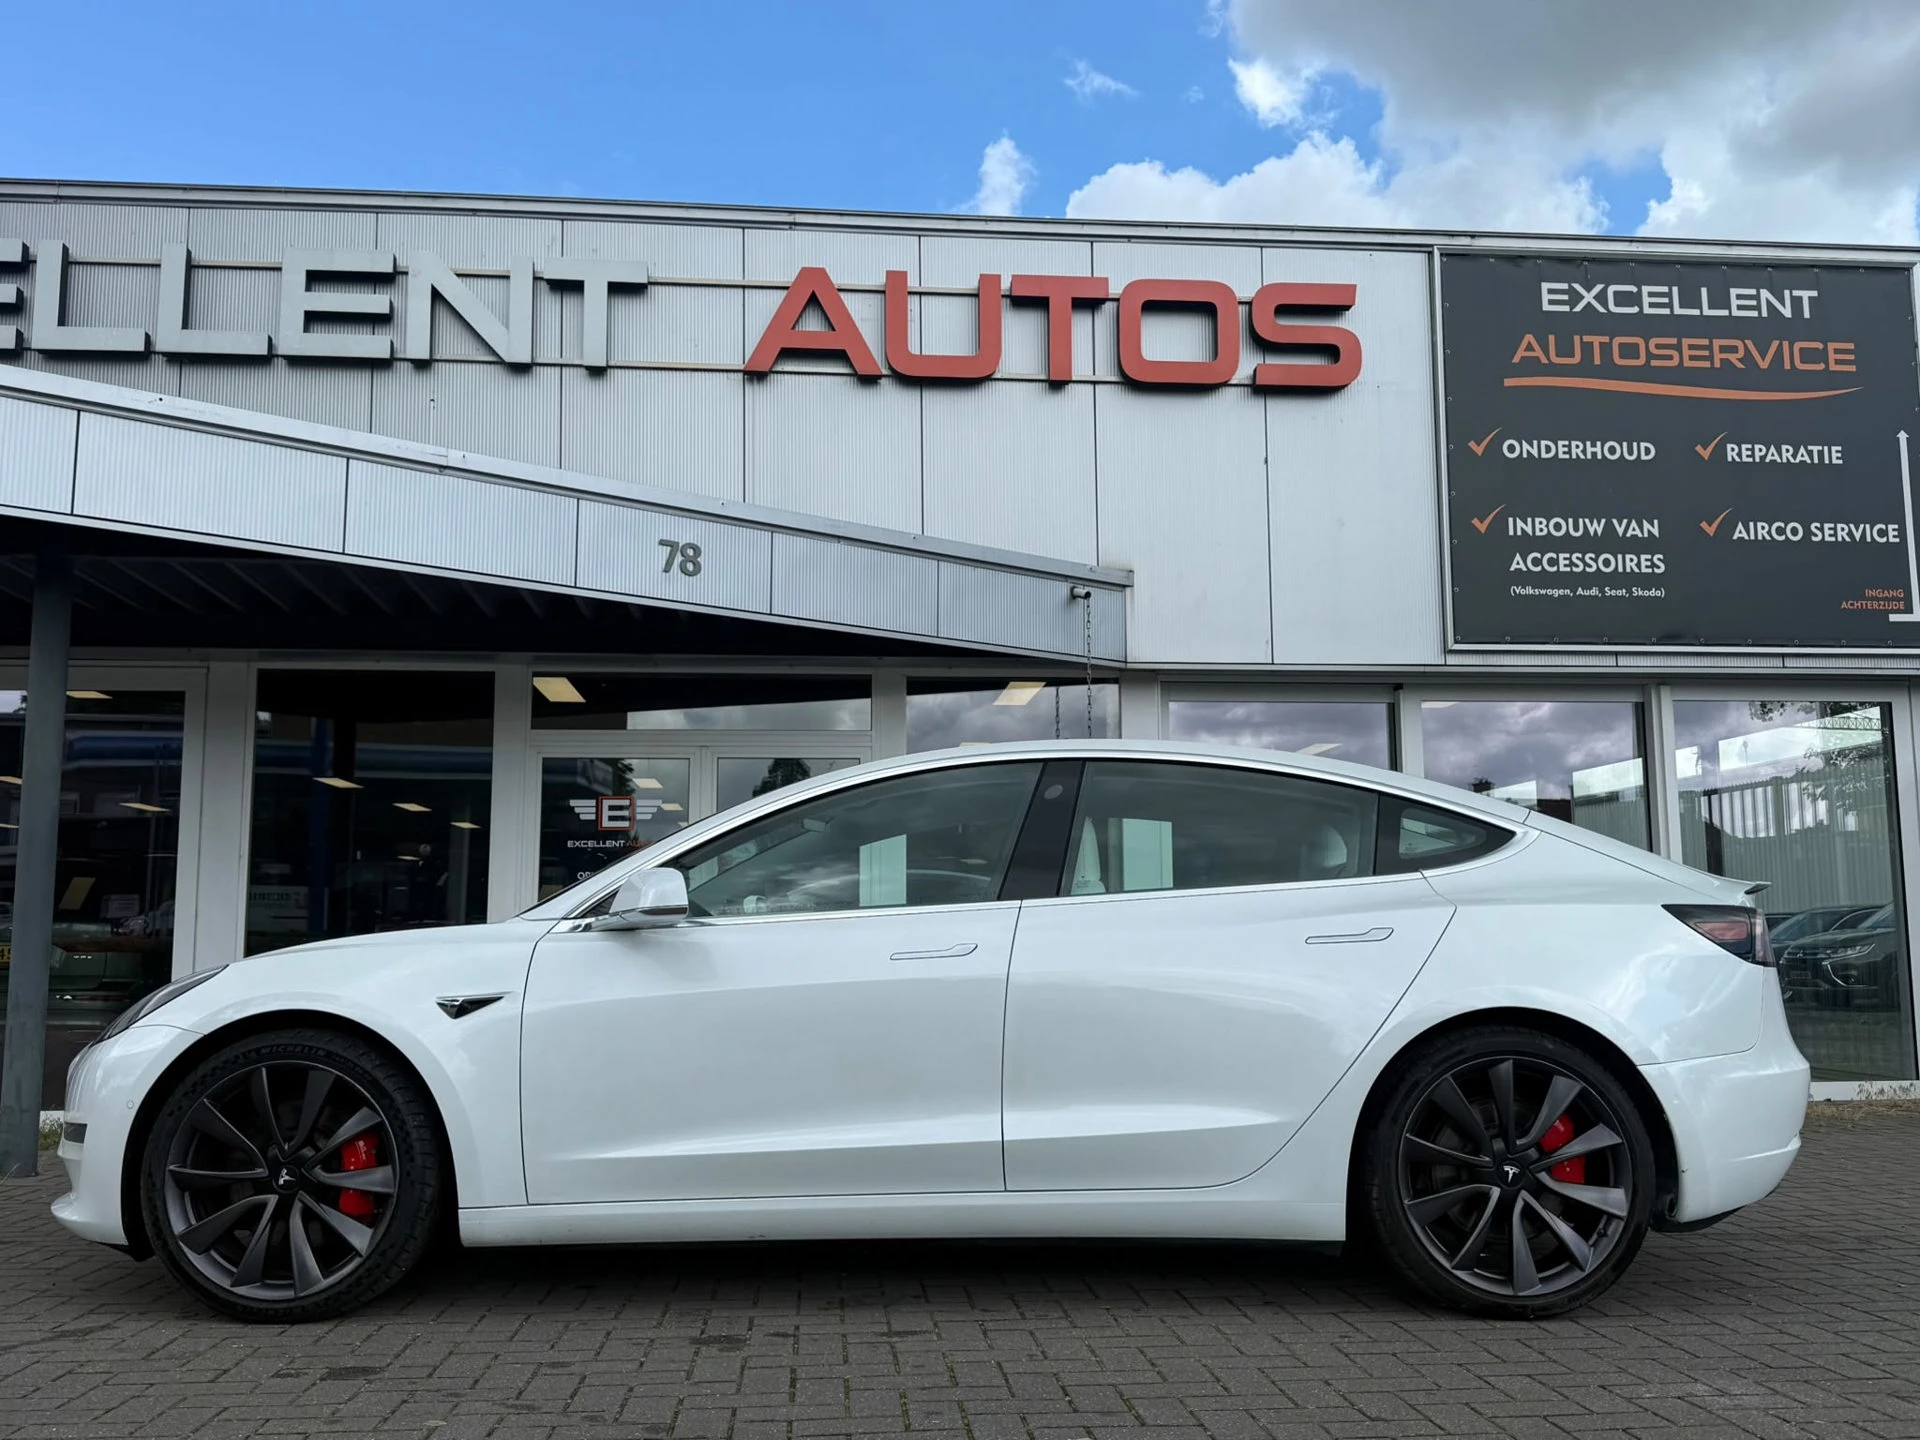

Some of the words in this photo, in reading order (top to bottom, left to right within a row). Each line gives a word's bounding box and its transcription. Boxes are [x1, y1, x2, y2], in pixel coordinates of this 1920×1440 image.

[1540, 281, 1819, 319] EXCELLENT
[743, 266, 1363, 388] AUTOS
[1511, 333, 1857, 372] AUTOSERVICE
[1502, 438, 1656, 461] ONDERHOUD
[1725, 443, 1844, 465] REPARATIE
[1507, 516, 1606, 539] INBOUW
[1611, 518, 1660, 539] VAN
[1732, 520, 1802, 542] AIRCO
[1809, 521, 1901, 544] SERVICE
[658, 539, 702, 577] 78
[1509, 551, 1666, 574] ACCESSOIRES
[1510, 585, 1573, 598] (Volkswagen,
[1576, 586, 1602, 597] Audi,
[1604, 586, 1630, 598] Seat,
[1632, 586, 1665, 598] Skoda)
[1865, 588, 1904, 598] INGANG
[1841, 600, 1904, 610] ACHTERZIJDE
[601, 799, 630, 828] E
[567, 840, 625, 848] EXCELLENT
[260, 1044, 327, 1057] MICHELIN
